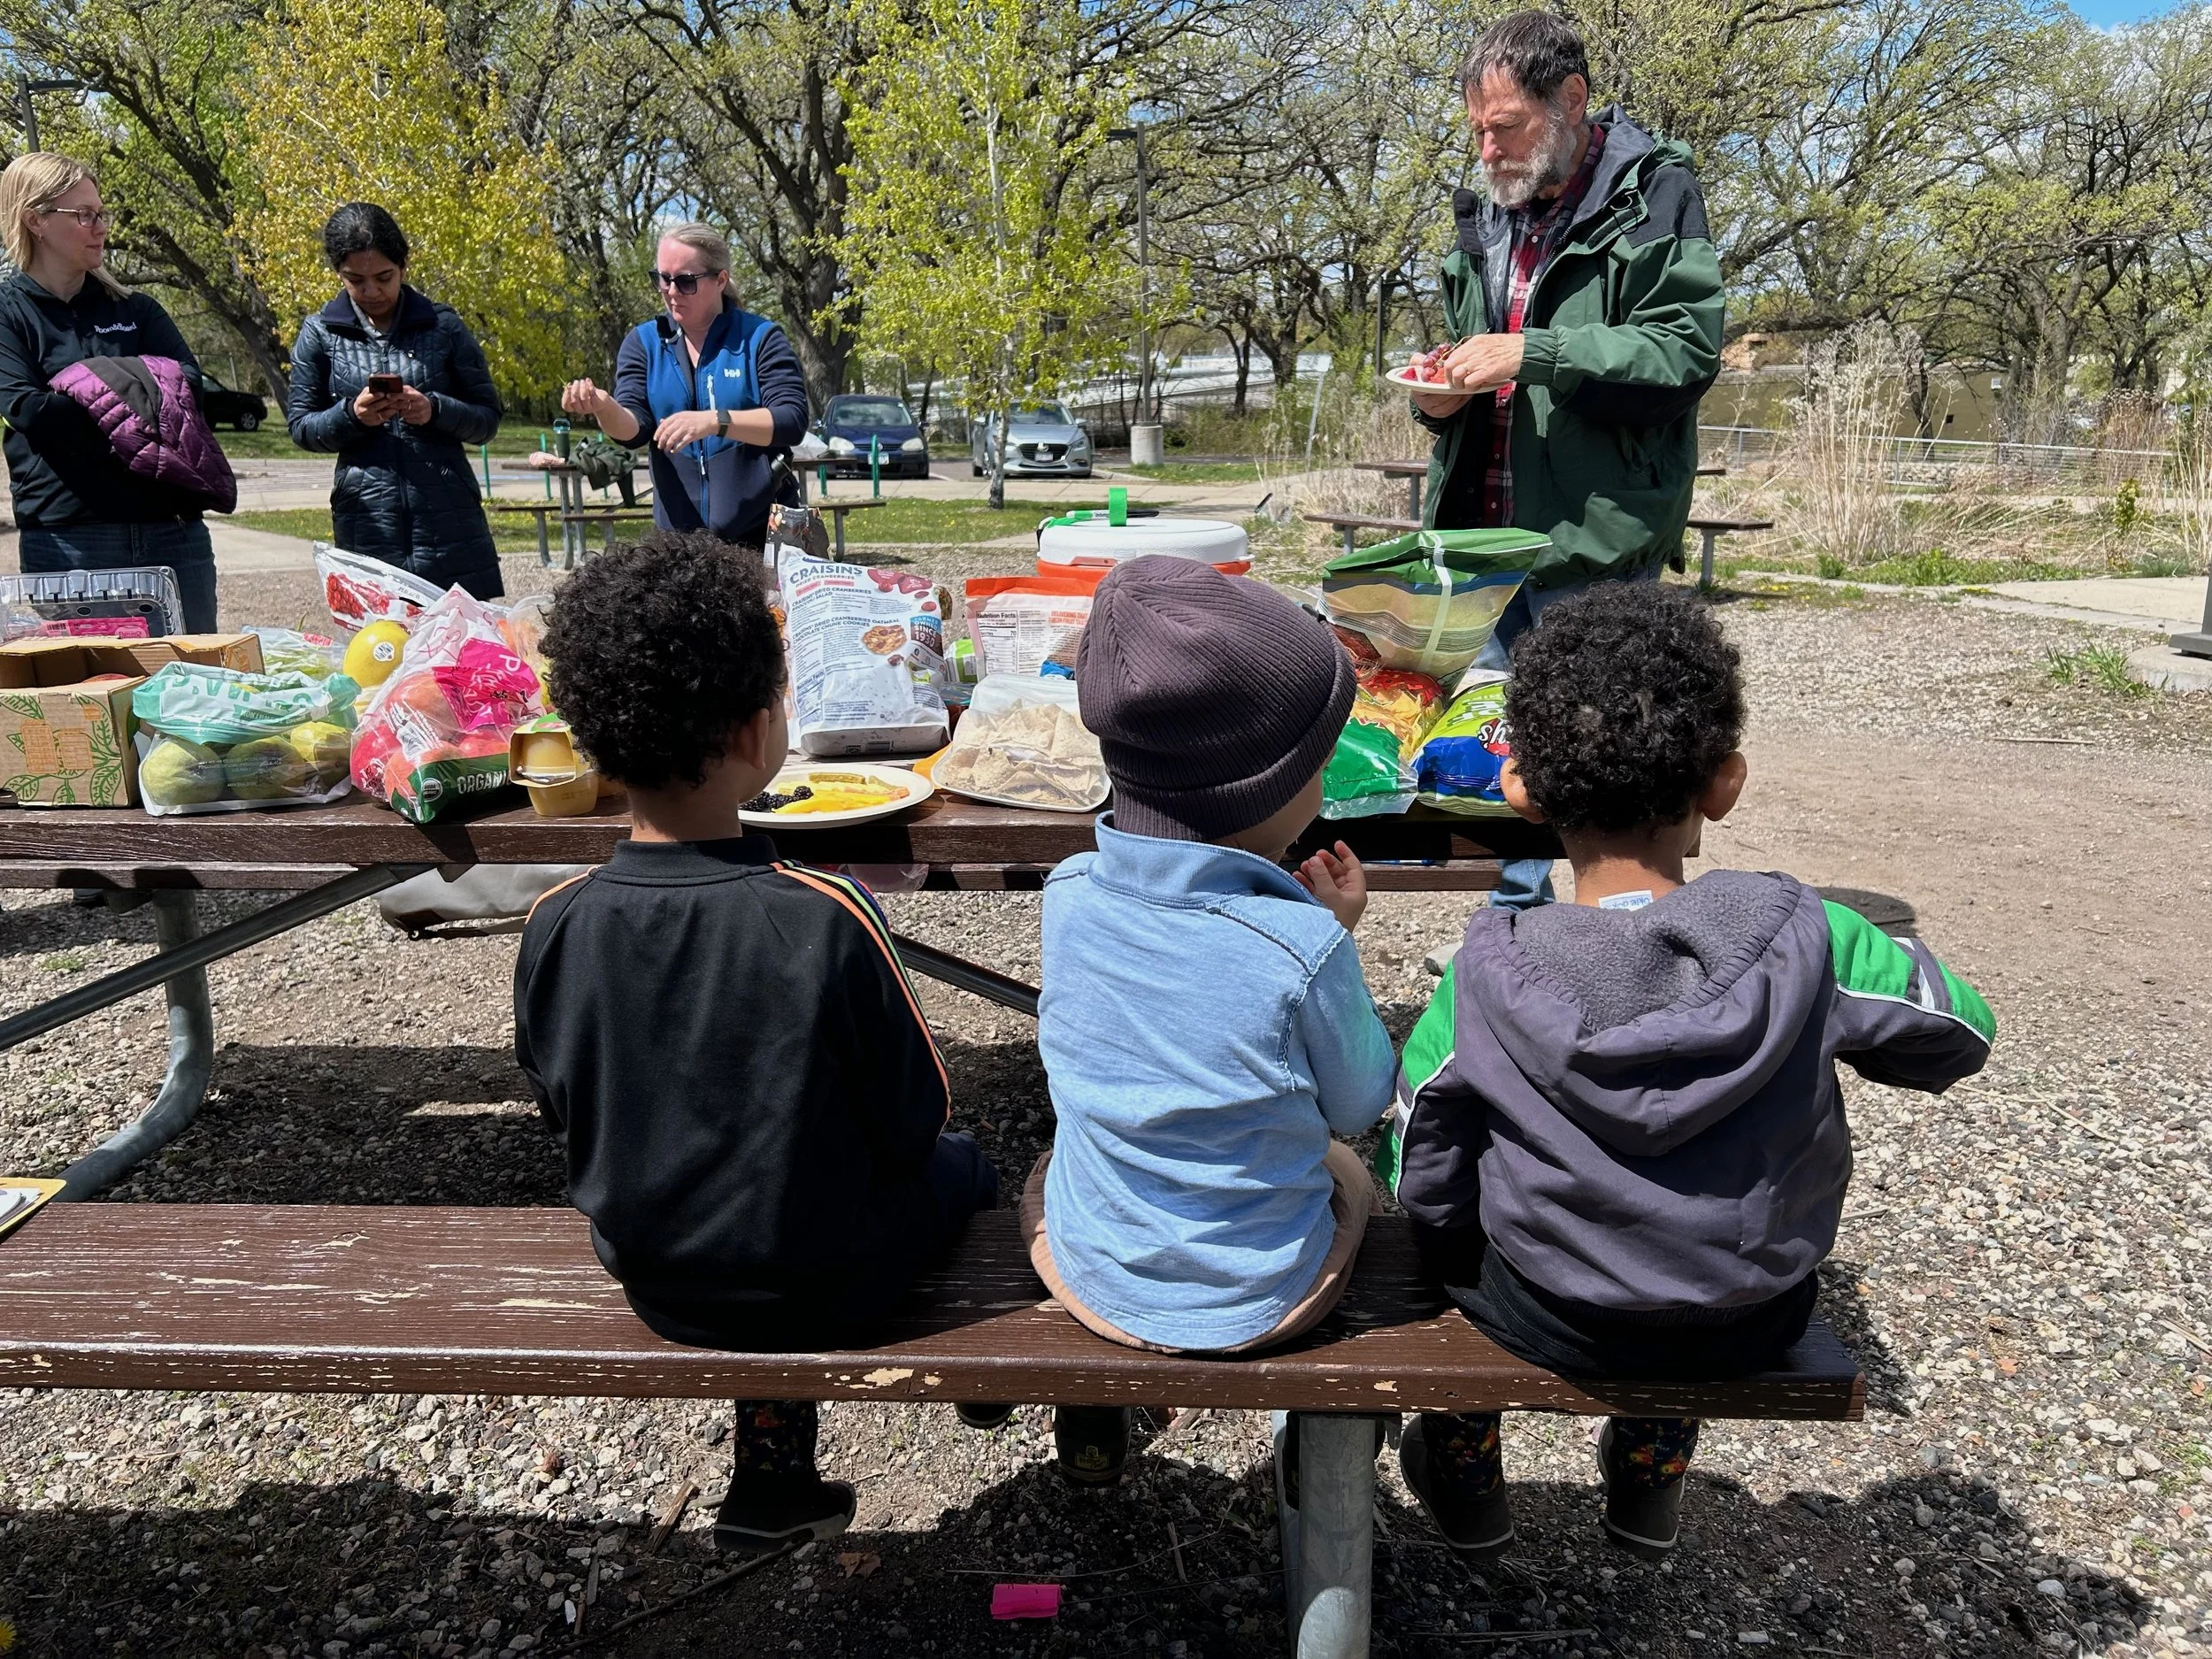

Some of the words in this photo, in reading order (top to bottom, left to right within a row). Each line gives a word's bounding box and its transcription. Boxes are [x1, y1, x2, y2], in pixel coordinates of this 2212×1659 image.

[789, 565, 863, 585] CRAISINS
[913, 625, 937, 638] SINCE
[914, 631, 935, 648] 1930
